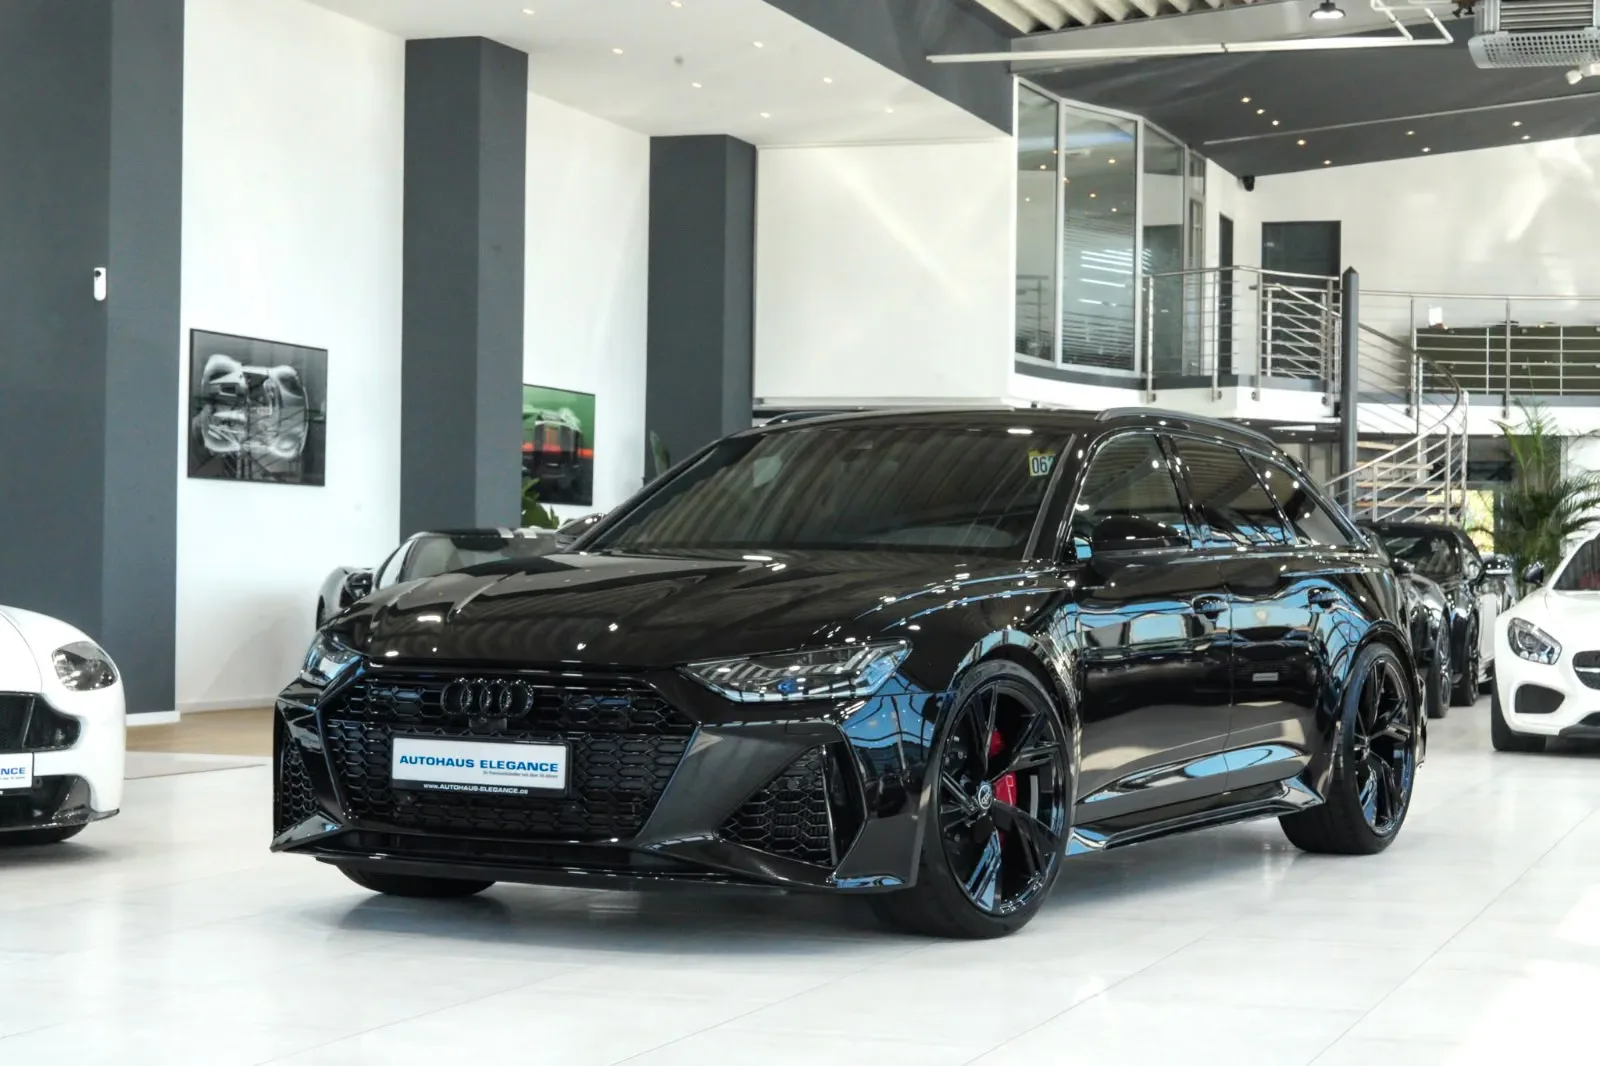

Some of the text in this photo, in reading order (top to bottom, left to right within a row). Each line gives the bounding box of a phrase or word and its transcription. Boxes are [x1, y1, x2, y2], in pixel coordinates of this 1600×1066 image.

[399, 755, 559, 773] AUTOHAUS ELEGANCE
[0, 767, 26, 776] NCE
